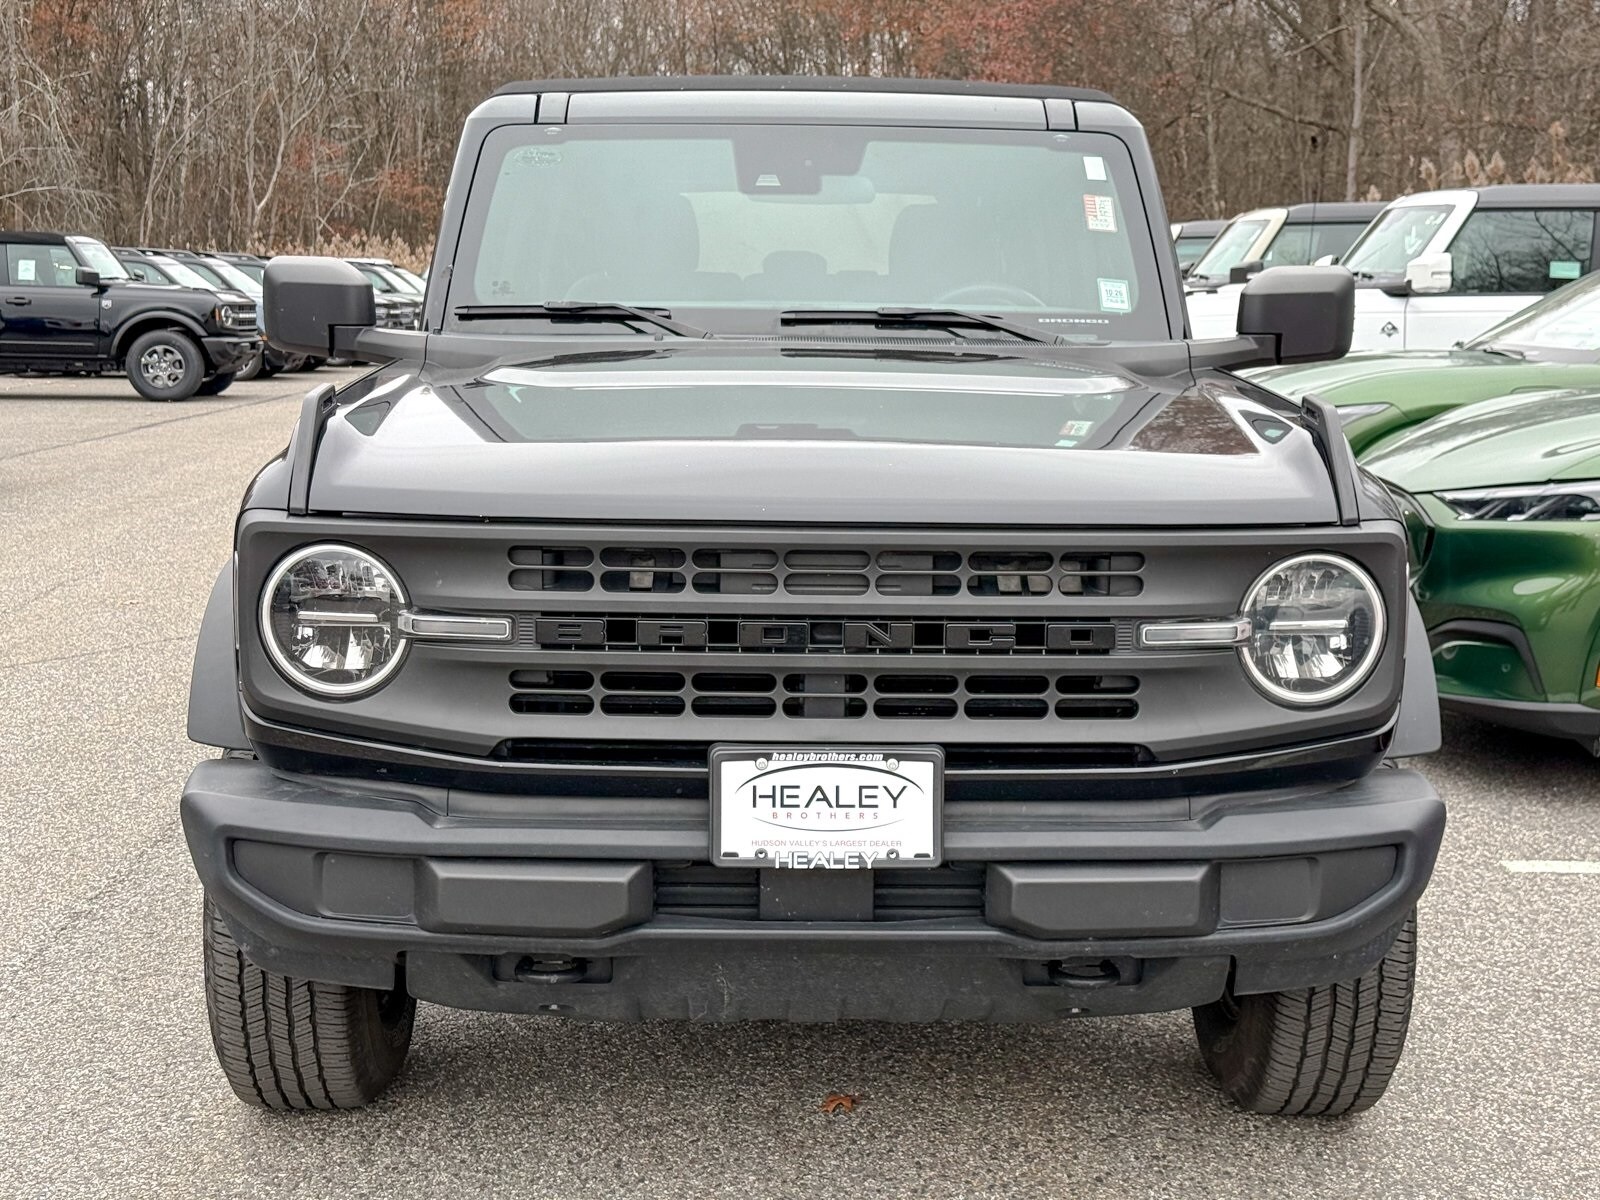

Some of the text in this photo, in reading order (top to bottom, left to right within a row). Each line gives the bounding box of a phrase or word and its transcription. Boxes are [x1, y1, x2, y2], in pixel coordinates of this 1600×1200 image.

[535, 617, 1116, 650] BRONCO
[771, 752, 884, 762] healeybrothers.com
[752, 785, 908, 809] HEALEY
[772, 811, 879, 820] BROTHERS
[751, 839, 902, 848] HUDSON VALLEY'S LARGEST DEALER
[774, 851, 880, 869] HEALEY
